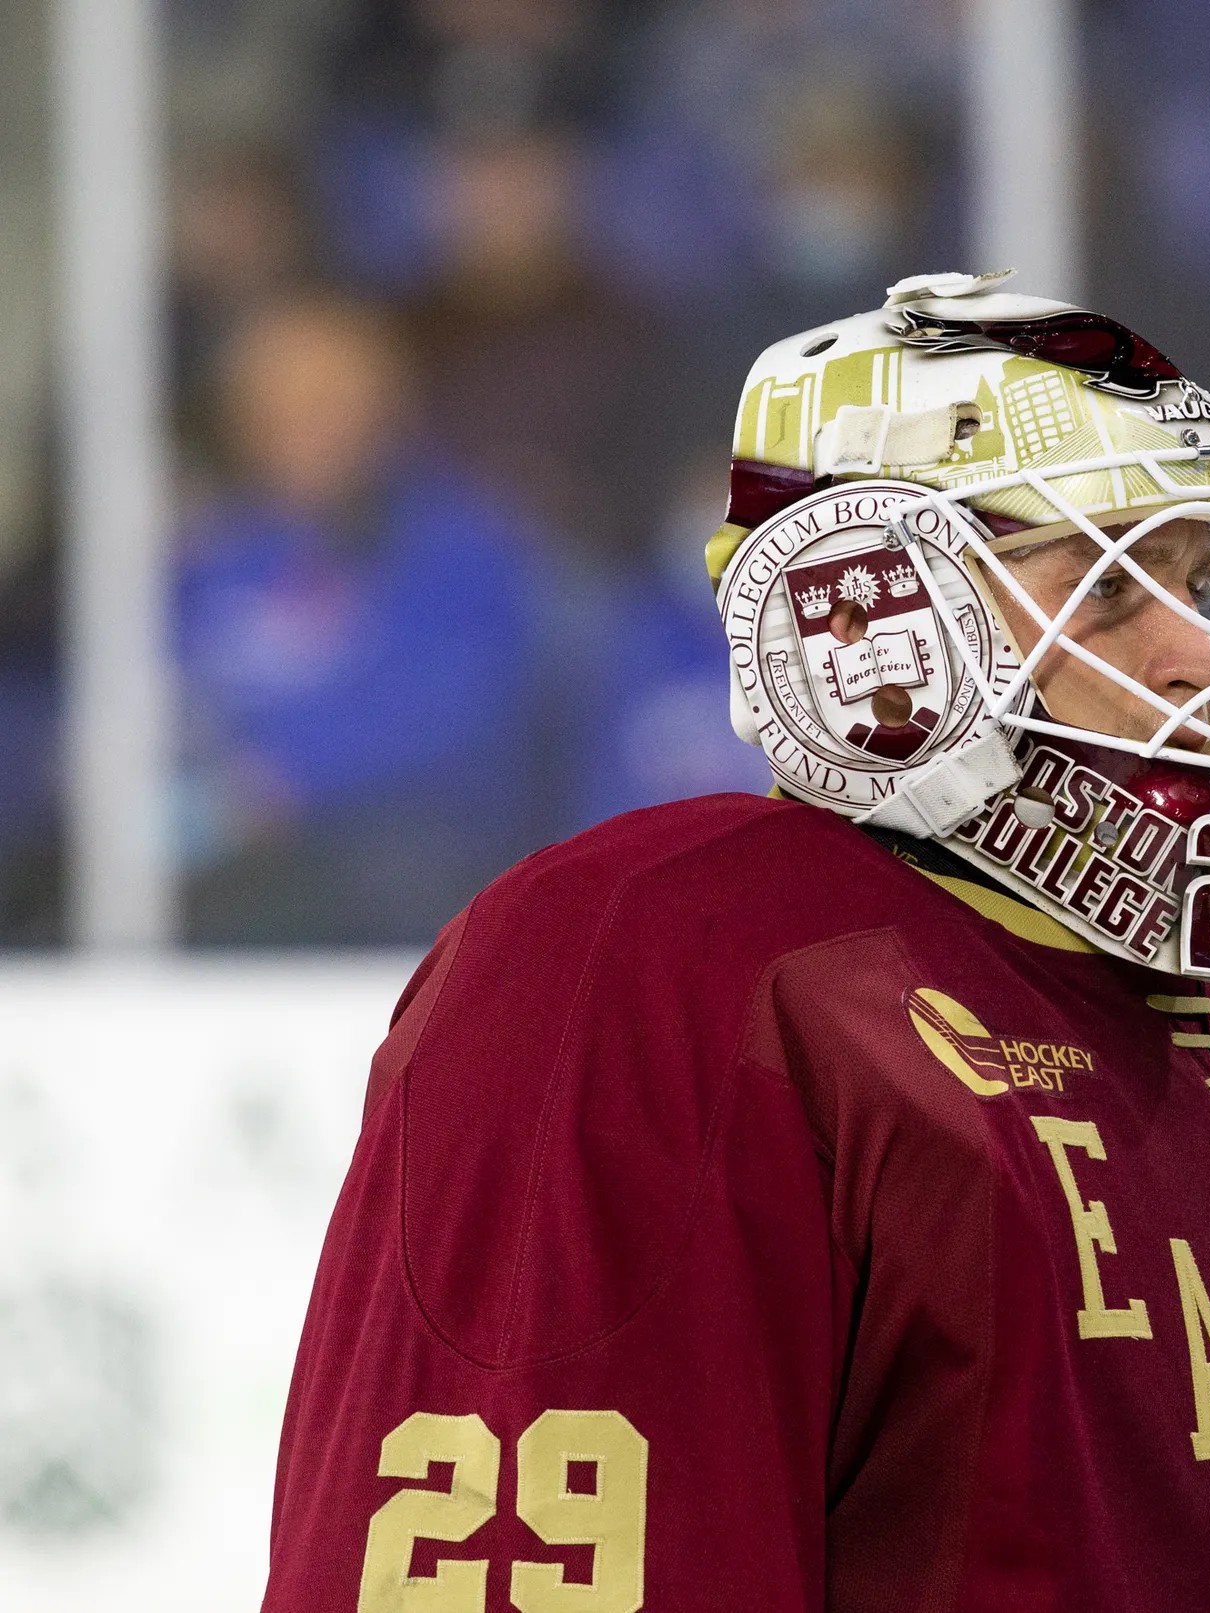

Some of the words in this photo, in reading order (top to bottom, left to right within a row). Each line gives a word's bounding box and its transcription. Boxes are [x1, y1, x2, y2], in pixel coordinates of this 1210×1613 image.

[731, 511, 822, 692] COLLEGIUM
[846, 580, 872, 597] IHS
[953, 676, 975, 715] BONIS
[806, 722, 825, 740] ET
[758, 717, 851, 799] FUND.
[1012, 735, 1190, 902] OSTON
[1000, 1040, 1094, 1072] HOCKEY
[1009, 1064, 1064, 1092] EAST
[356, 1408, 650, 1613] 29
